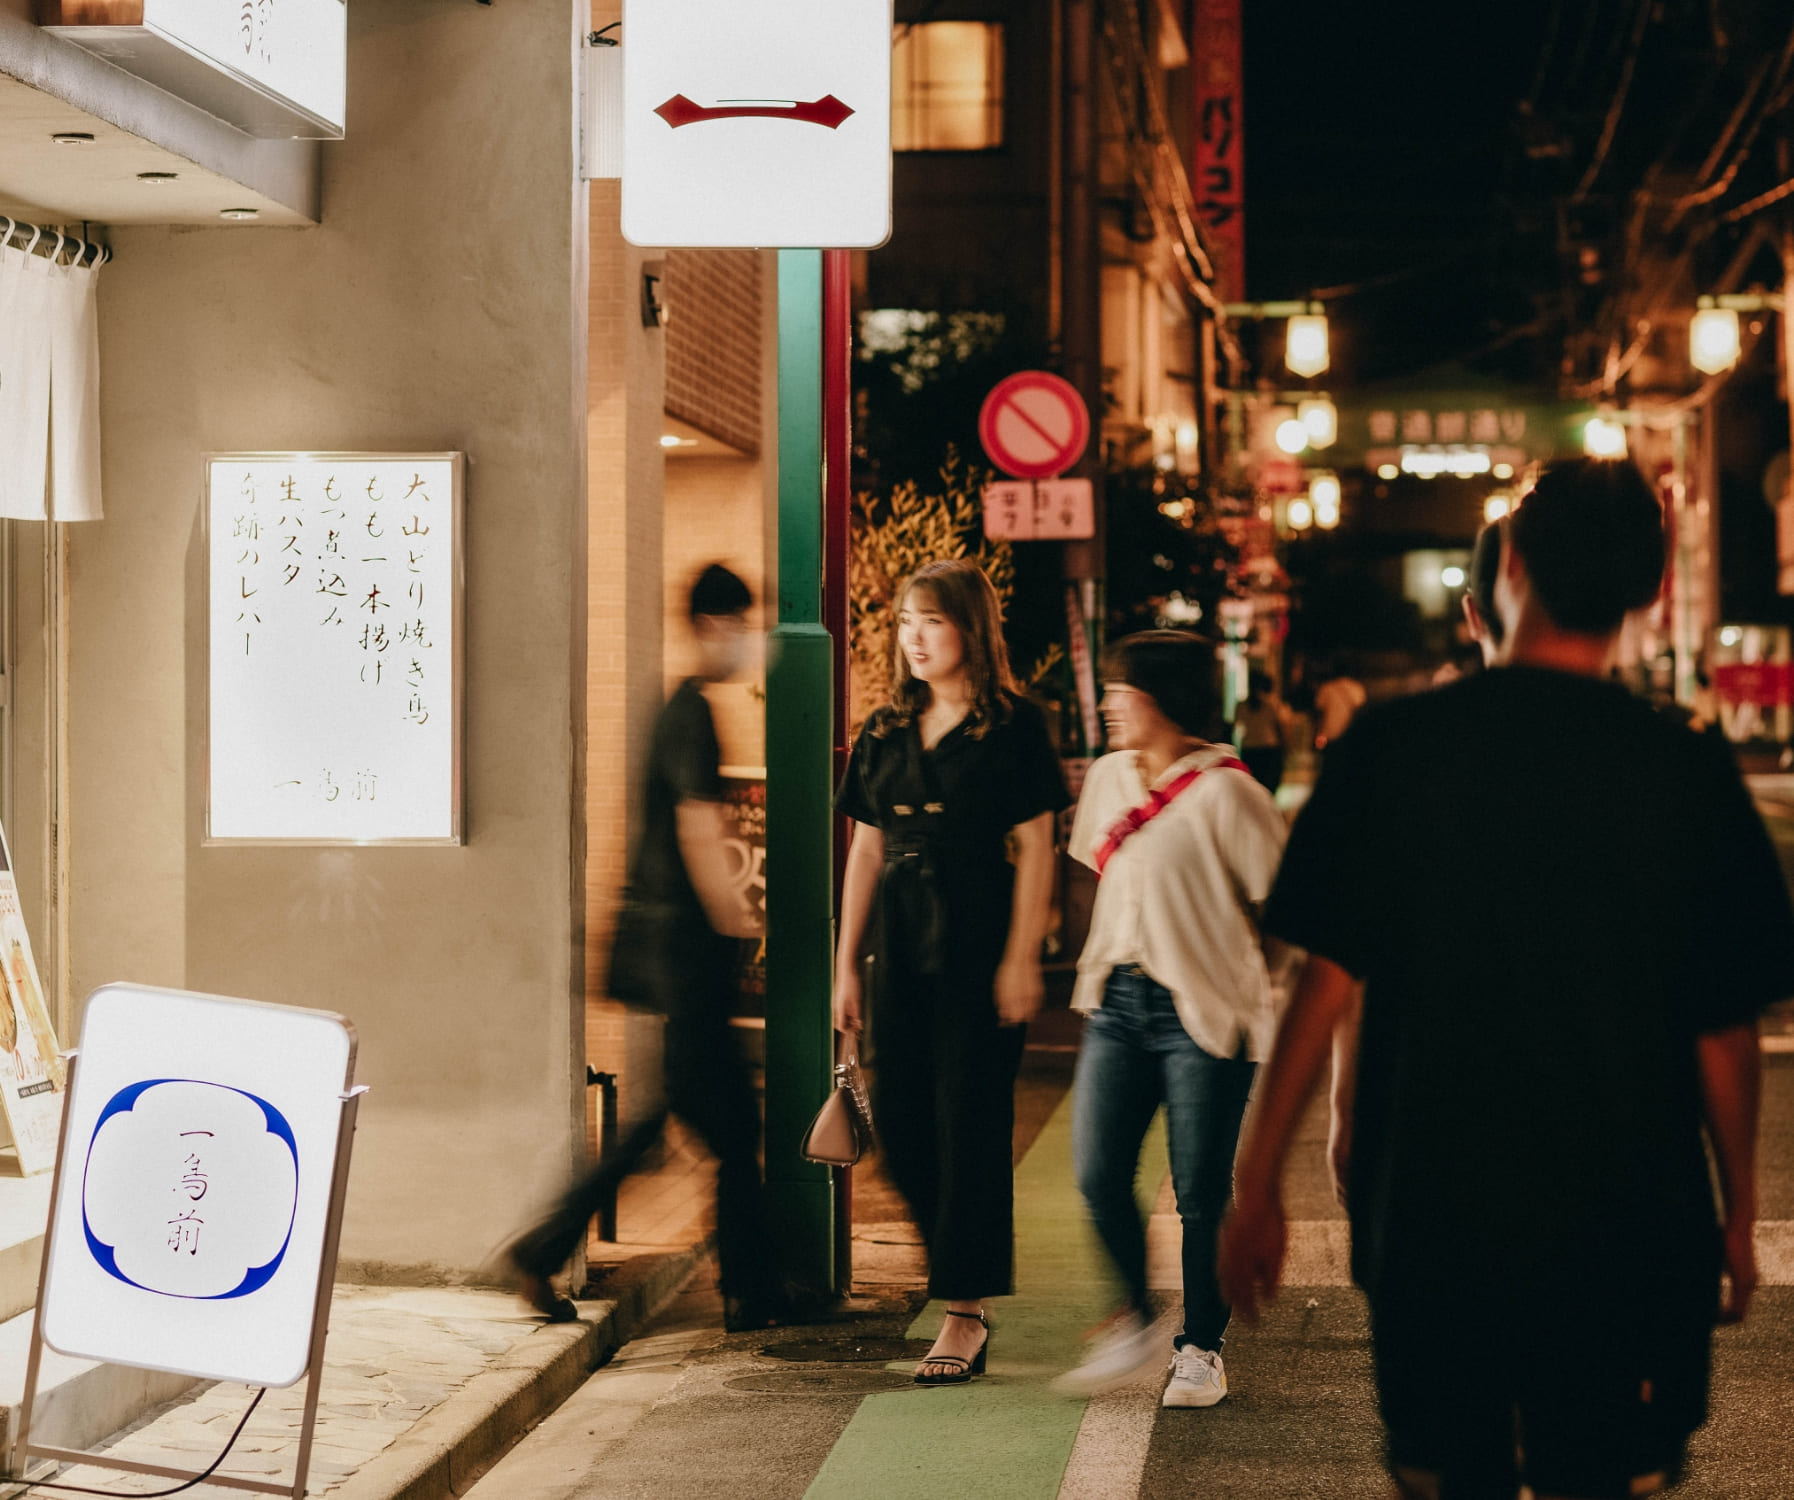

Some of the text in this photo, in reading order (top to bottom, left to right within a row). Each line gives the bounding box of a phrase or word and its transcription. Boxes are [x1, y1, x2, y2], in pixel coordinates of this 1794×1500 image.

[312, 473, 348, 627] もつ煮込み
[358, 475, 391, 688] もも一本揚げ
[167, 1130, 215, 1256] 一鳥前
